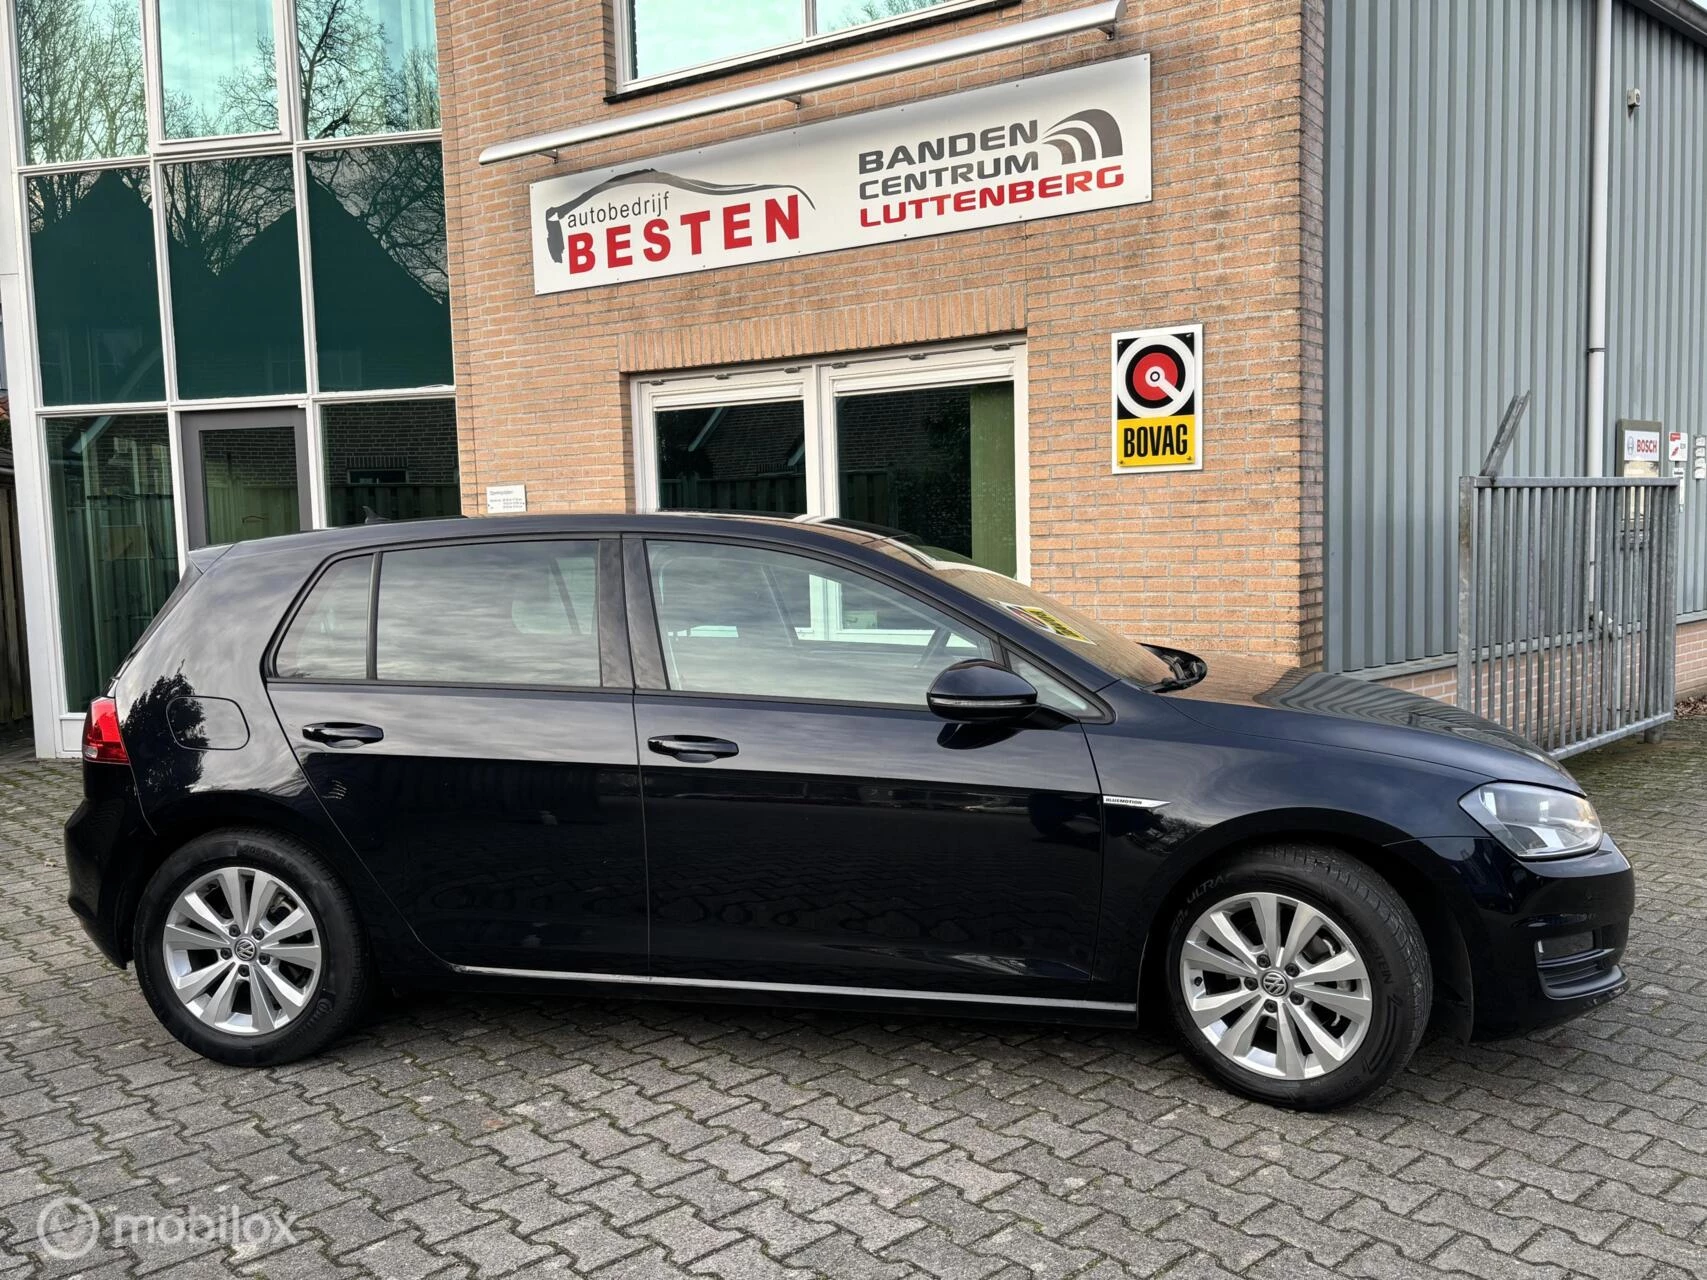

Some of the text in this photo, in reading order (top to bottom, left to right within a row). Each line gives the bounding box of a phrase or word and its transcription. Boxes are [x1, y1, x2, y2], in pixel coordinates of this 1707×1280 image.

[859, 120, 1039, 175] BANDEN
[859, 151, 1039, 200] CENTRUM
[860, 165, 1125, 228] LUTTENBERG
[567, 191, 670, 228] autobedrijf
[567, 194, 800, 275] BESTEN
[1123, 424, 1188, 458] BOVAG
[1637, 439, 1657, 452] BOSCH
